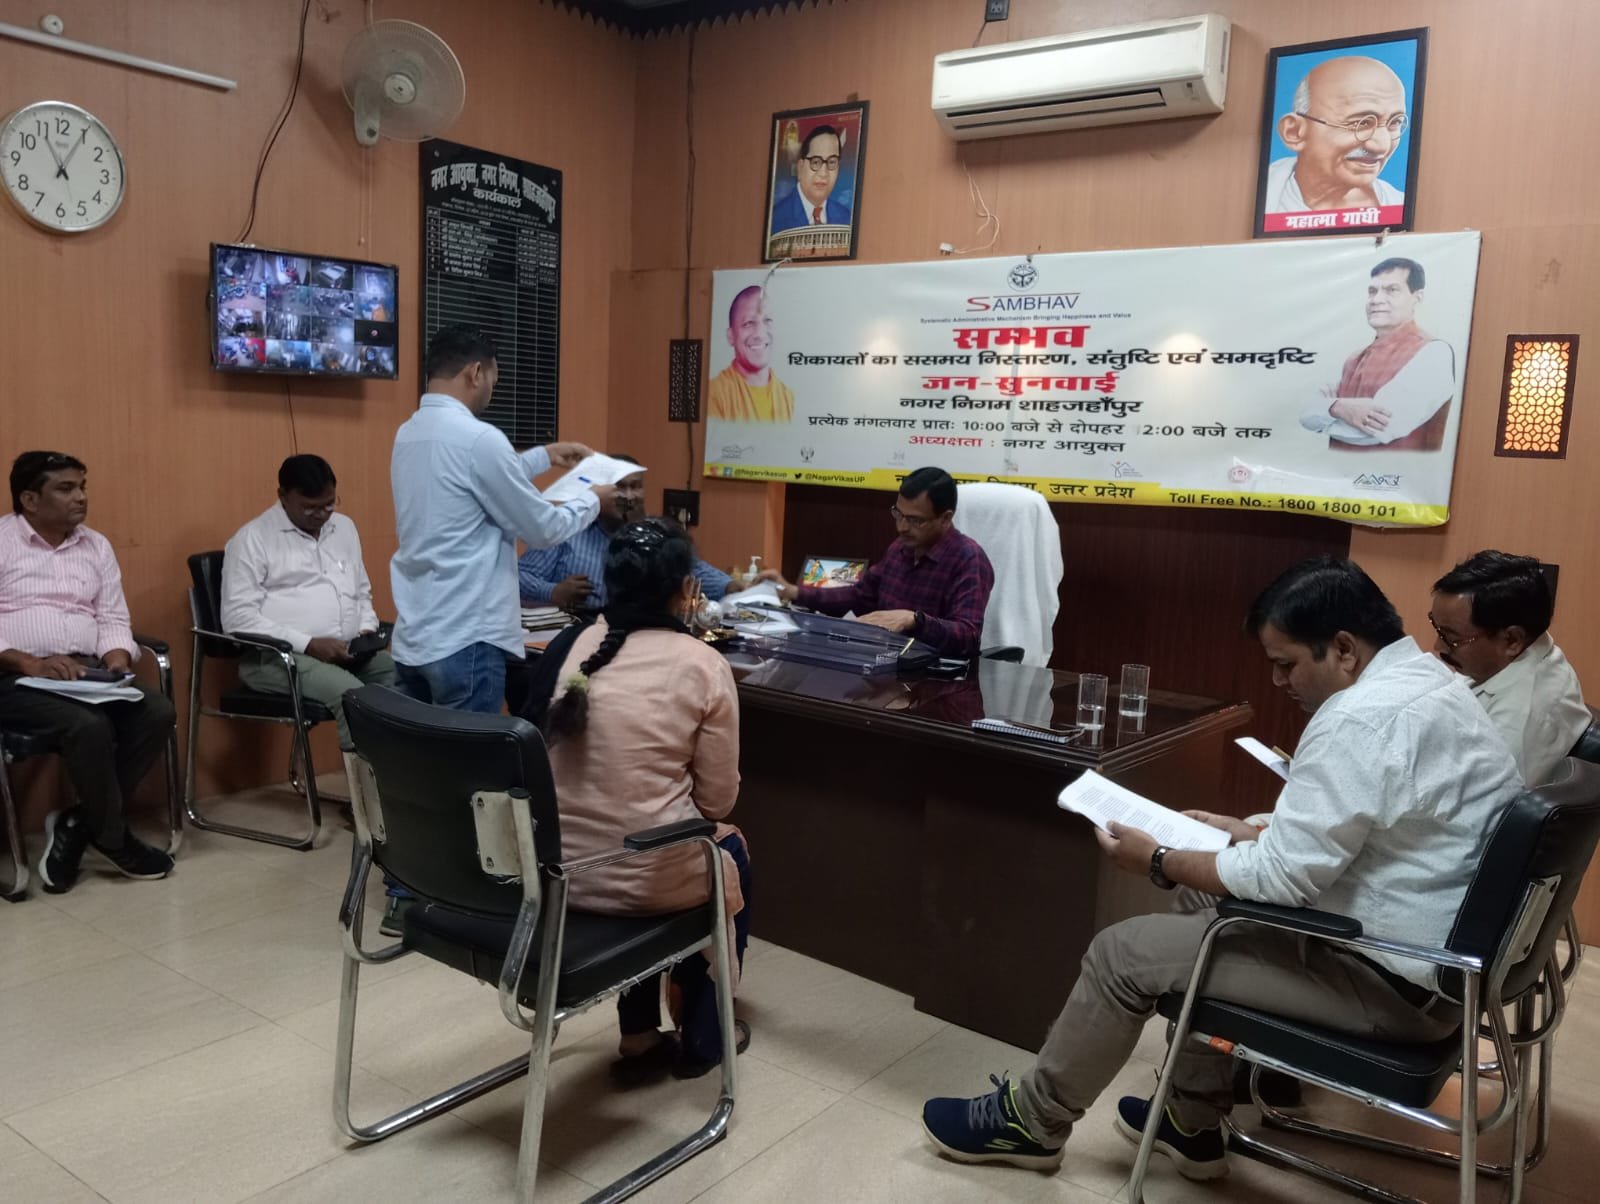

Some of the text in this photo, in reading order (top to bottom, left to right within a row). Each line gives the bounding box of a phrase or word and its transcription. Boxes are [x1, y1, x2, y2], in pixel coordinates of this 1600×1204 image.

[36, 119, 49, 138] 11
[55, 117, 70, 136] 12
[19, 131, 36, 150] 10
[10, 150, 21, 166] 9
[93, 146, 104, 163] 2
[18, 173, 29, 191] 8
[99, 168, 110, 185] 3
[34, 191, 45, 208] 7
[92, 189, 102, 205] 4
[55, 202, 66, 218] 6
[76, 200, 87, 217] 5
[1285, 207, 1381, 228] महात्मा गांधी
[966, 293, 1081, 312] SAMBHAV
[952, 325, 1091, 350] सम्भव
[788, 351, 869, 366] शिकायतों
[872, 354, 899, 366] का
[903, 354, 973, 366] ससमय
[1086, 348, 1162, 370] संतुष्टि
[1166, 348, 1208, 365] एवं
[1210, 347, 1317, 370] समदृष्टि
[921, 371, 1120, 396] जन-सुनवाई
[900, 395, 1143, 418] नगर निगम शाहजहाँपुर
[808, 413, 849, 428] प्रत्येक
[853, 414, 917, 429] मंगलवार
[963, 420, 1005, 432] 10:00
[1010, 418, 1040, 433] बजे
[1046, 418, 1064, 433] से
[1069, 418, 1126, 435] दोपहर
[1192, 422, 1227, 438] बजे
[1234, 426, 1273, 440] तक
[908, 435, 982, 448] अध्यक्षता
[1002, 439, 1047, 450] नगर
[1054, 440, 1126, 455] आयुक्त
[805, 472, 866, 483] @NagarVikasUP
[1050, 482, 1091, 496] उत्तर
[1094, 483, 1136, 499] प्रदेश
[1169, 492, 1397, 517] Toll Free No.: 1800 1800 101
